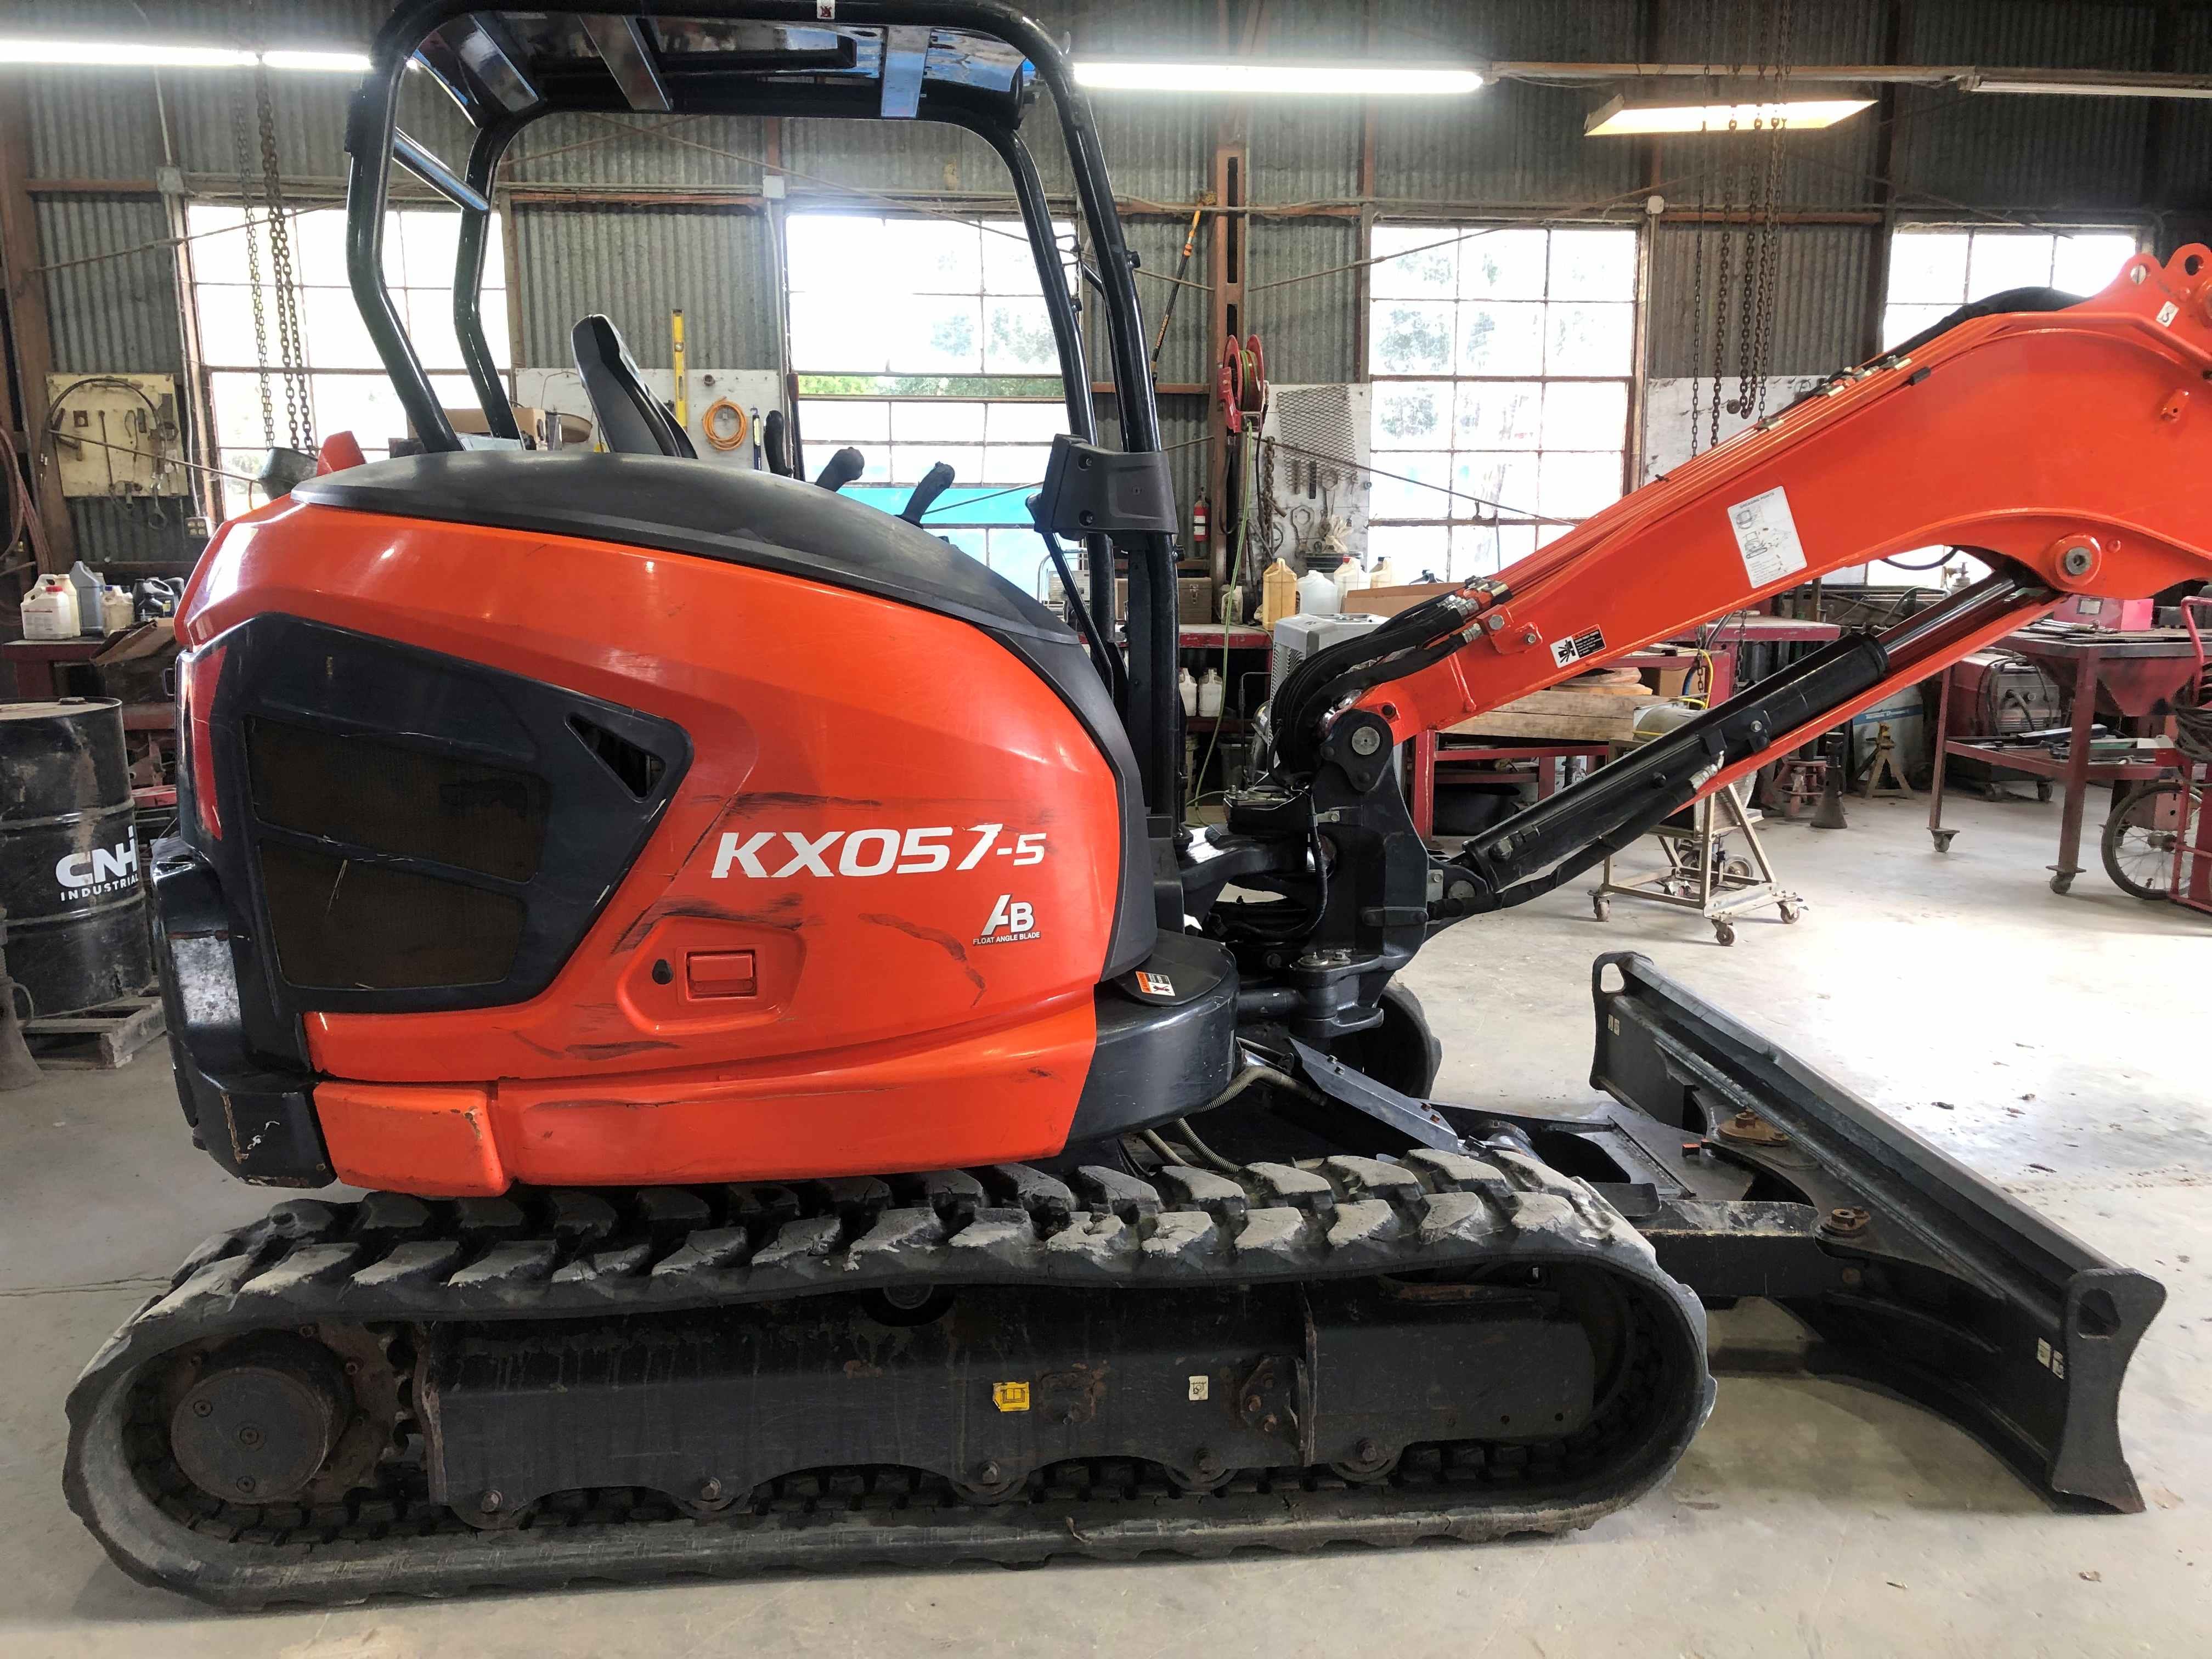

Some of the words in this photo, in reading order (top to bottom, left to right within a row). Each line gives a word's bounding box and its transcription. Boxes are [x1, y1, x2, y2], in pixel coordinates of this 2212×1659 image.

[711, 823, 1047, 879] KX057-5
[60, 873, 139, 901] INDUSTRIAL
[980, 894, 1035, 936] AB
[973, 936, 995, 945] FLOAT
[996, 934, 1018, 943] ANGLE
[1019, 932, 1041, 940] BLADE
